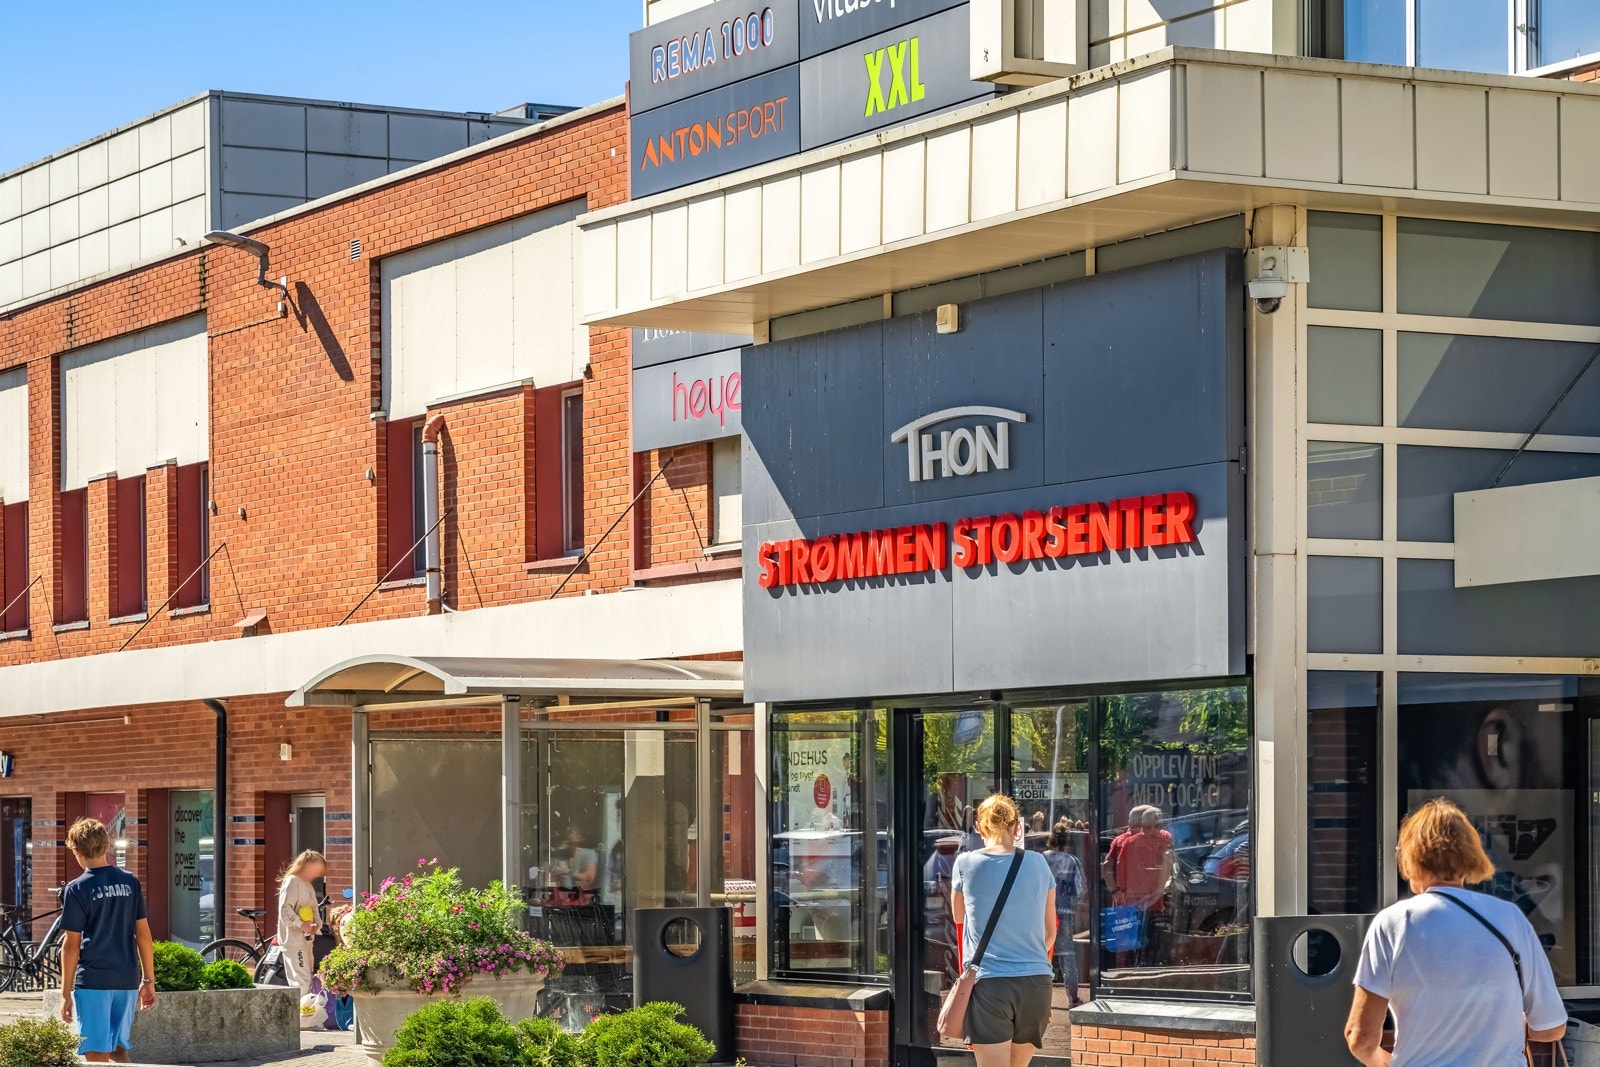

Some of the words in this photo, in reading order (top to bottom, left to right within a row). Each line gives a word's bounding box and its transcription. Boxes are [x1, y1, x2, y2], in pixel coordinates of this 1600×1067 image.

[651, 35, 717, 84] REMA
[721, 7, 775, 57] 1000
[864, 37, 925, 118] XXL
[891, 404, 1027, 483] THON
[758, 521, 946, 588] STRØMMEN
[952, 491, 1196, 567] STORSENTER
[1133, 754, 1188, 779] OPPLEV
[174, 806, 203, 822] discover
[174, 826, 185, 843] the
[174, 853, 196, 869] power
[174, 870, 182, 887] of
[183, 870, 204, 890] plants
